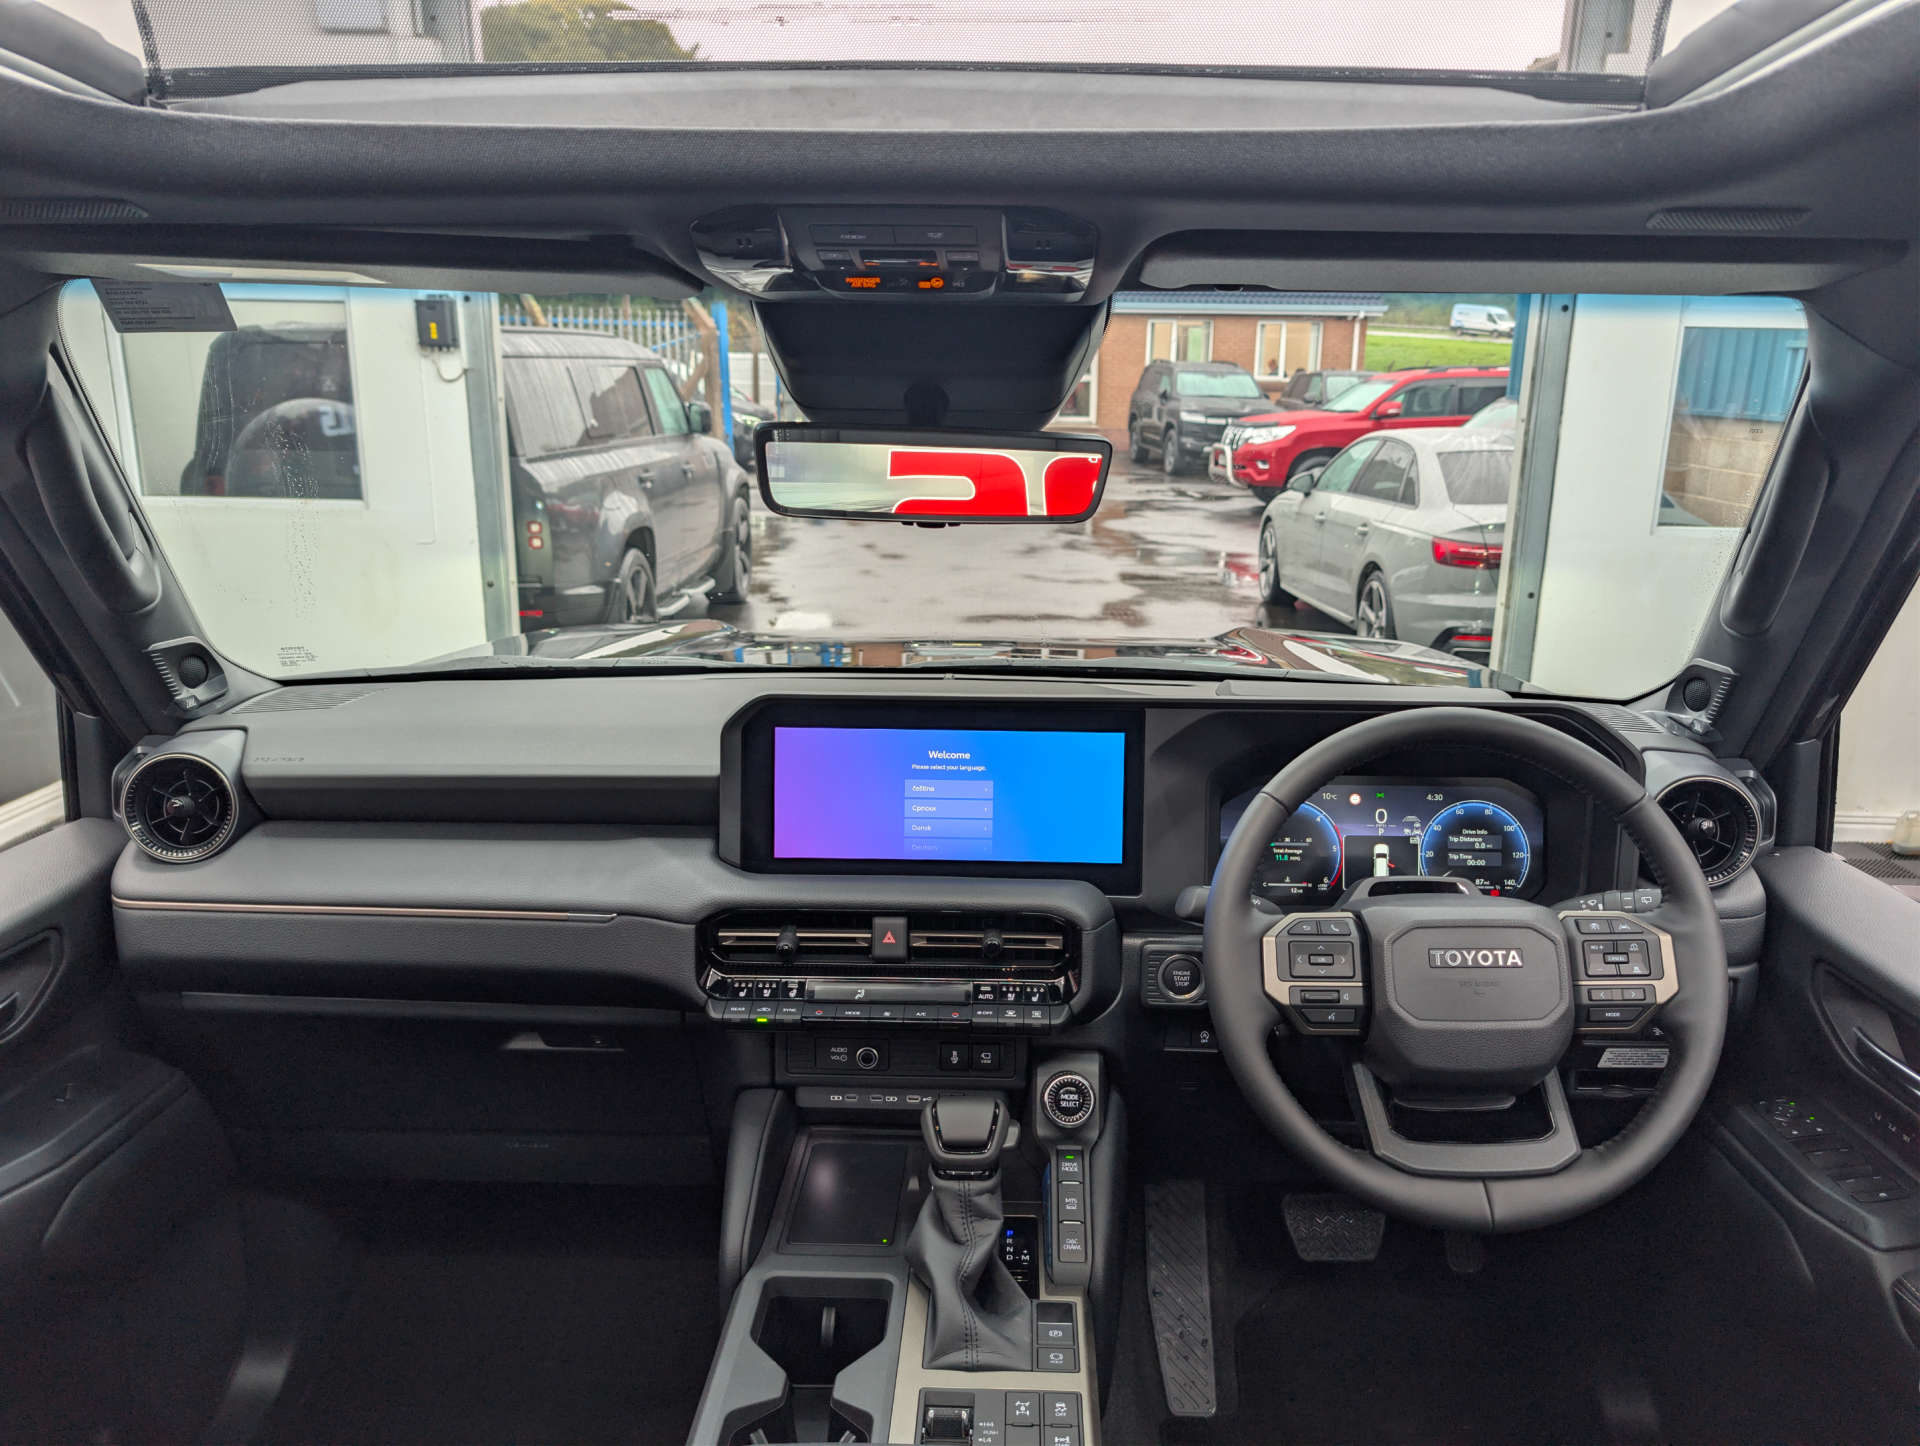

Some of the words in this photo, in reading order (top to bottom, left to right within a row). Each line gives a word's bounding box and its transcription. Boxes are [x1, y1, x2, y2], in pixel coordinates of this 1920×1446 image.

[928, 750, 971, 760] Welcome
[930, 763, 946, 771] select
[946, 764, 959, 772] your
[1425, 793, 1444, 801] 4:30
[1375, 808, 1388, 824] 0
[1432, 824, 1442, 832] 40
[1430, 949, 1523, 967] TOYOTA
[977, 993, 994, 1001] AUTO
[1060, 1093, 1079, 1101] MODE
[1060, 1100, 1080, 1108] SELECT
